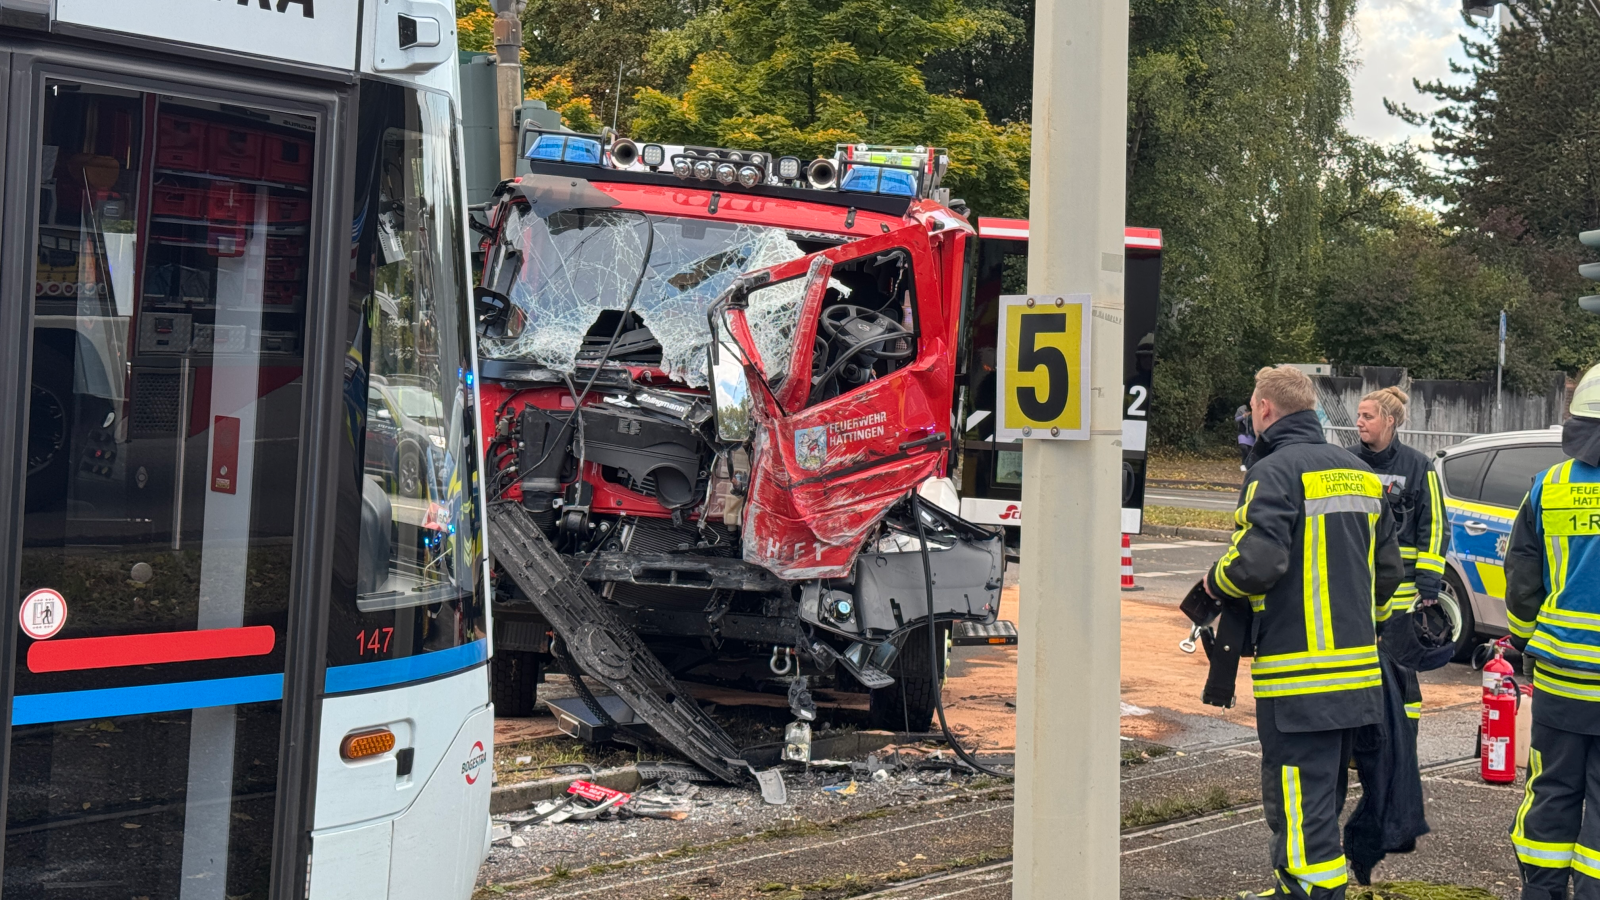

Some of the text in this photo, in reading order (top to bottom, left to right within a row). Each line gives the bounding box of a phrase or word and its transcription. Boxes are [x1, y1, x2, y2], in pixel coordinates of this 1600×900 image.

[53, 85, 58, 96] 1
[1016, 313, 1069, 422] 5
[1124, 385, 1148, 416] 2
[829, 411, 887, 434] FEUERWEHR
[829, 425, 885, 447] HATTINGEN
[1320, 472, 1365, 483] FEUERWEHR
[1325, 483, 1367, 493] HATTINGEN
[356, 627, 394, 656] 147
[461, 752, 487, 774] BOGESTRA
